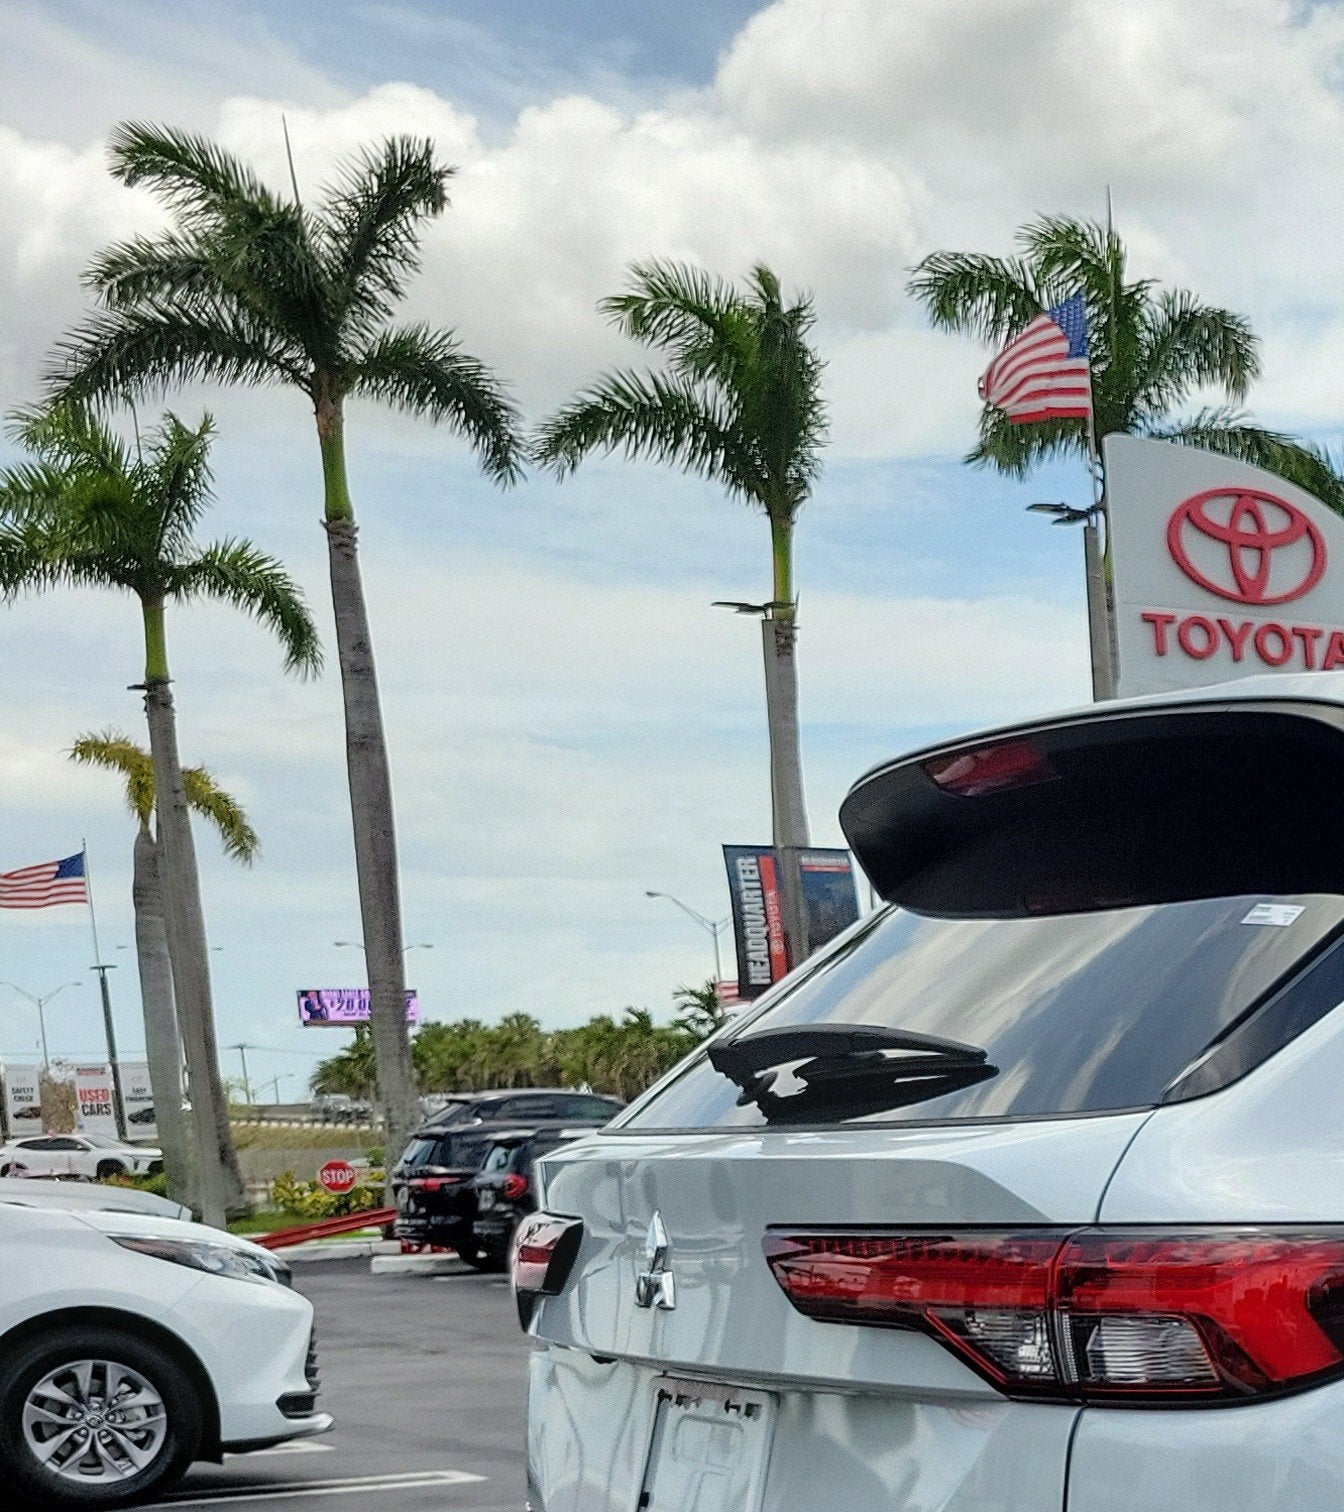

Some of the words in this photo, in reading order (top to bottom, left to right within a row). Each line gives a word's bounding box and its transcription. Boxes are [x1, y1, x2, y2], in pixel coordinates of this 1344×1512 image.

[738, 857, 771, 984] HEADQUARTER
[79, 1088, 109, 1103] USED
[82, 1103, 111, 1116] CARS
[322, 1169, 353, 1184] STOP
